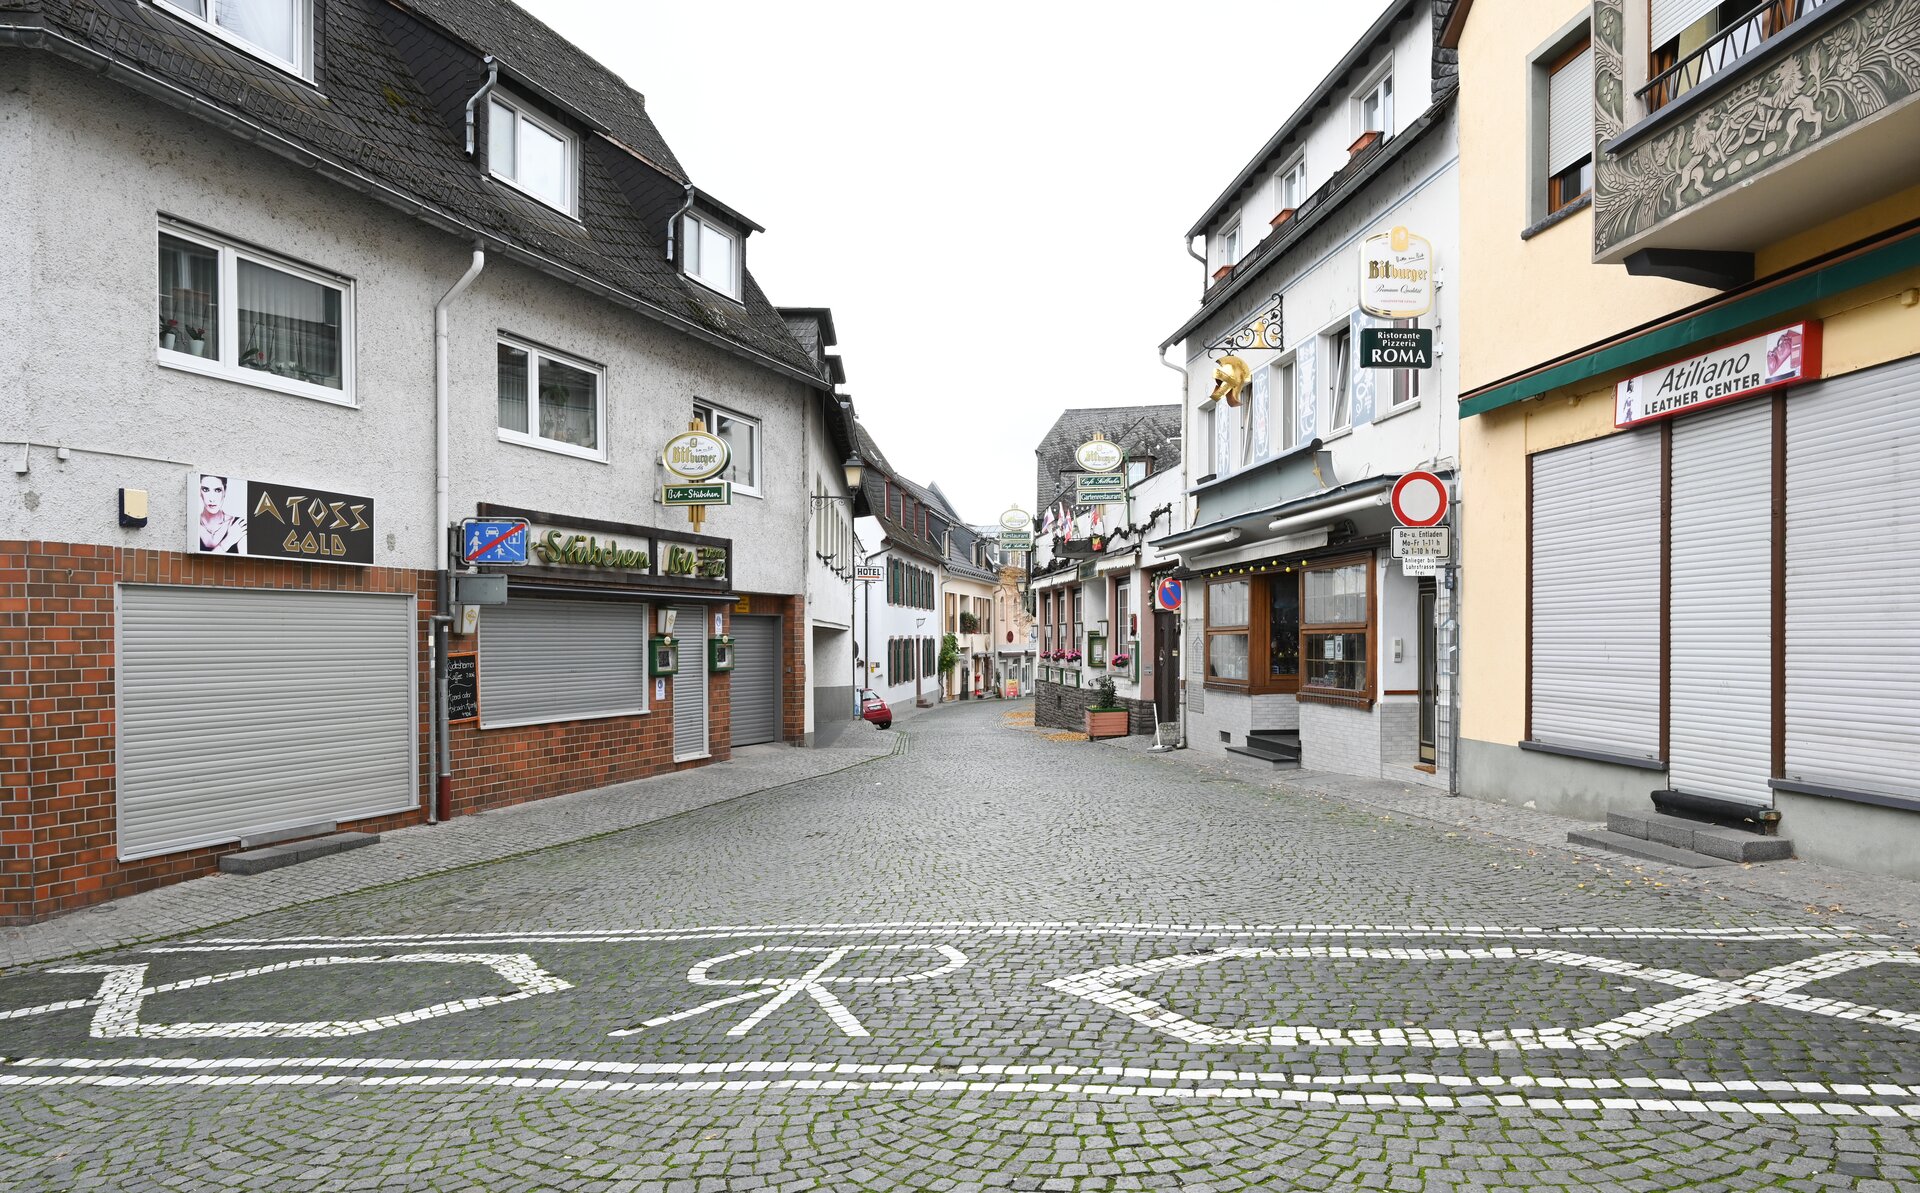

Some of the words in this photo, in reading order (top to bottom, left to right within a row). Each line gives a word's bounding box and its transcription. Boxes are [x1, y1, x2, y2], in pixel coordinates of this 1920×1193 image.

[1368, 260, 1427, 282] Bitburger
[1377, 331, 1420, 339] Ristorante
[1382, 339, 1416, 347] Pizzeria
[1371, 348, 1426, 363] ROMA
[1657, 352, 1750, 396] Atiliano
[1645, 390, 1698, 415] LEATHER
[1705, 372, 1760, 399] CENTER
[672, 446, 716, 466] Bitburger
[253, 491, 370, 532] ATOSS
[283, 529, 347, 556] GOLD
[857, 568, 880, 576] HOTEL
